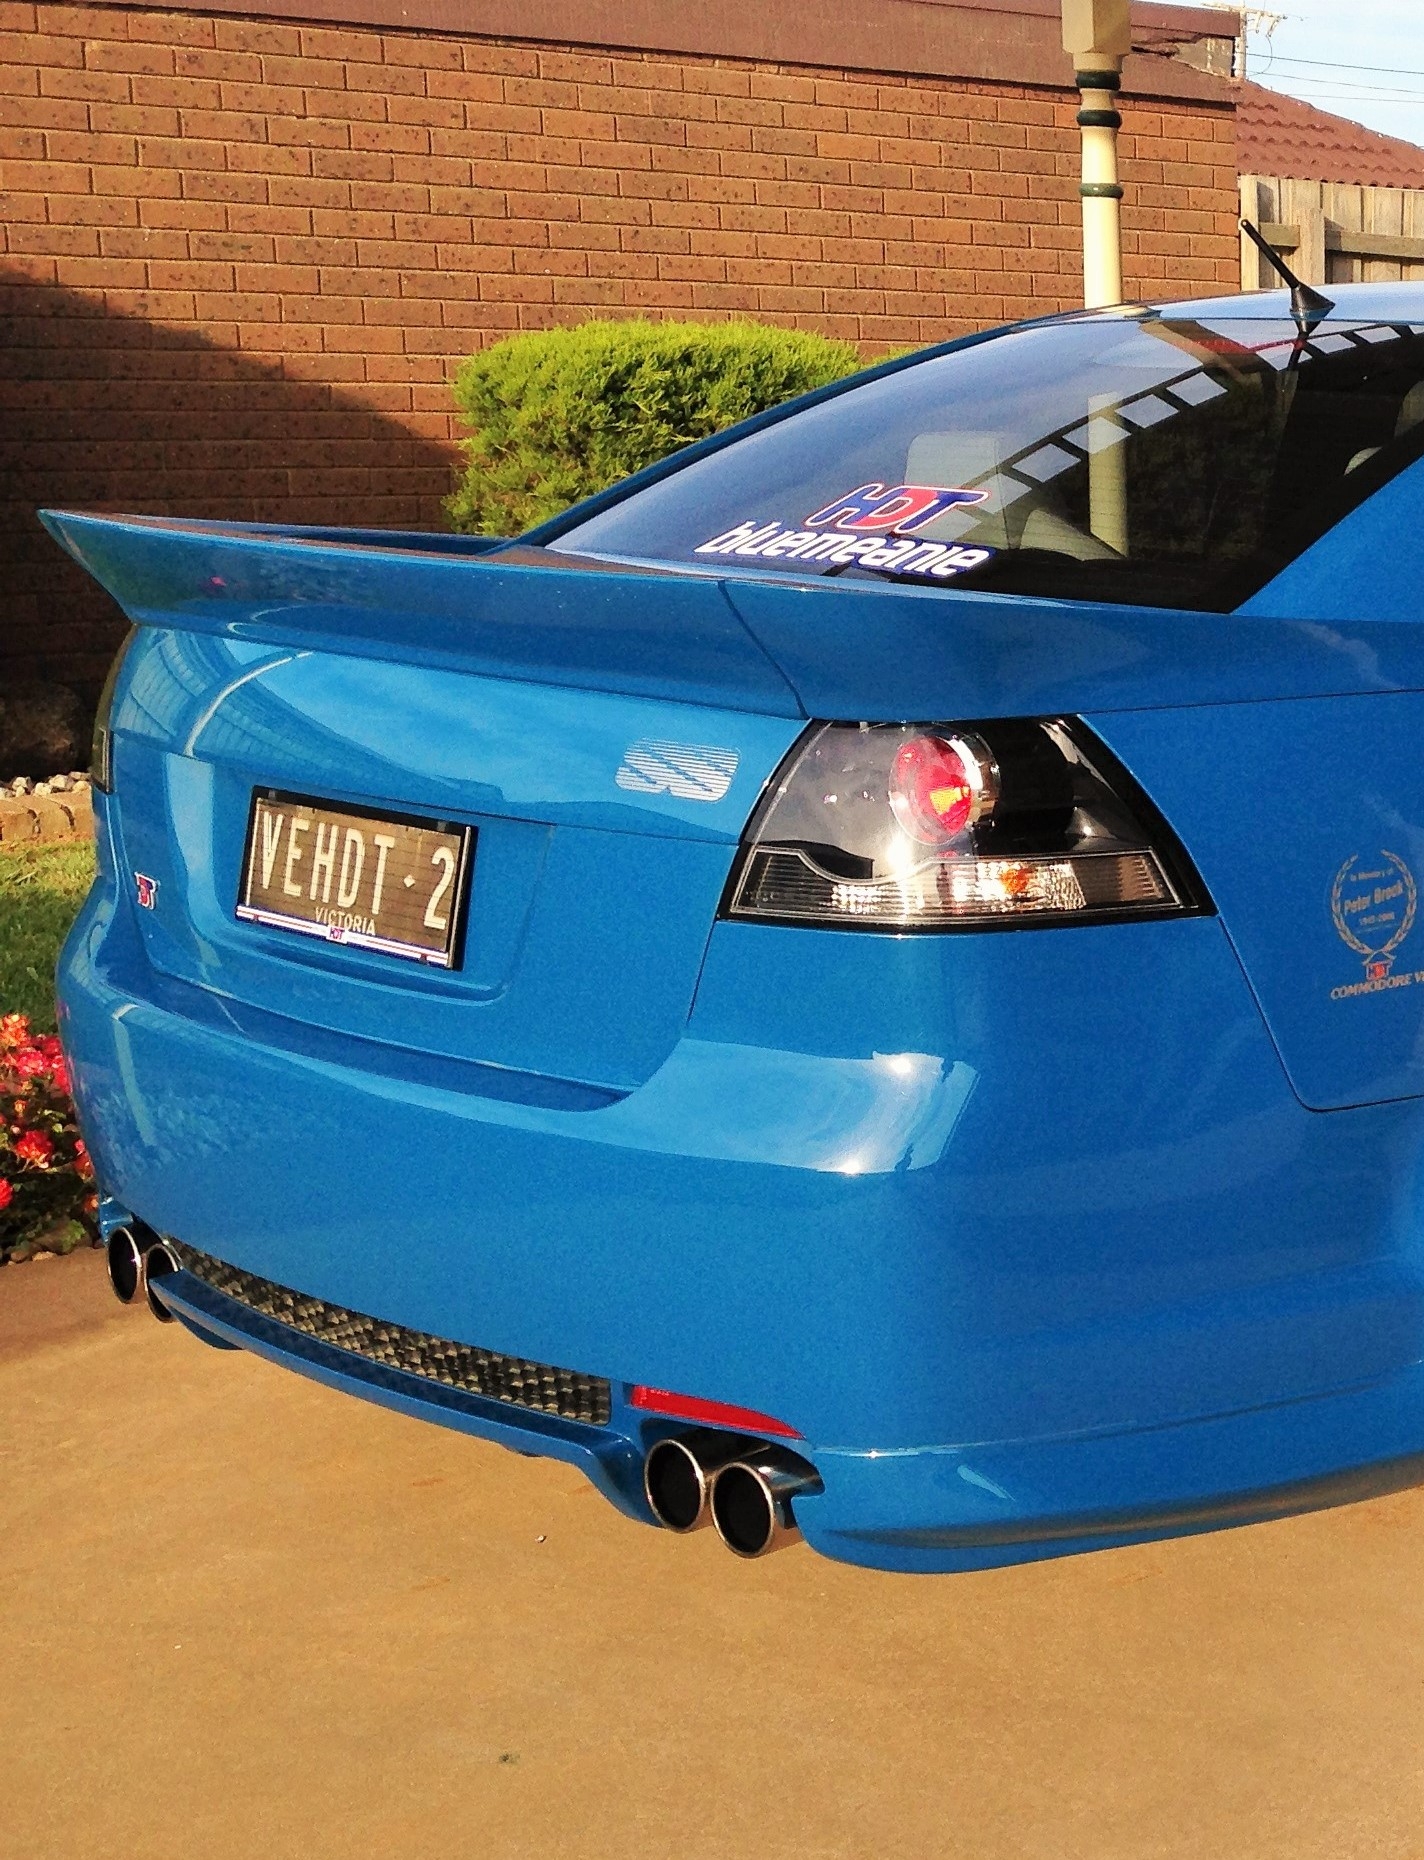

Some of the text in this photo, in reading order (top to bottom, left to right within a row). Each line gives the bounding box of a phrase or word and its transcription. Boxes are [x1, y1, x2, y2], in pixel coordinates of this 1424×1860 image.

[805, 482, 989, 534] HDT
[694, 521, 989, 575] bluemeanie
[315, 906, 376, 936] VICTORIA
[1330, 973, 1413, 999] COMMODORE
